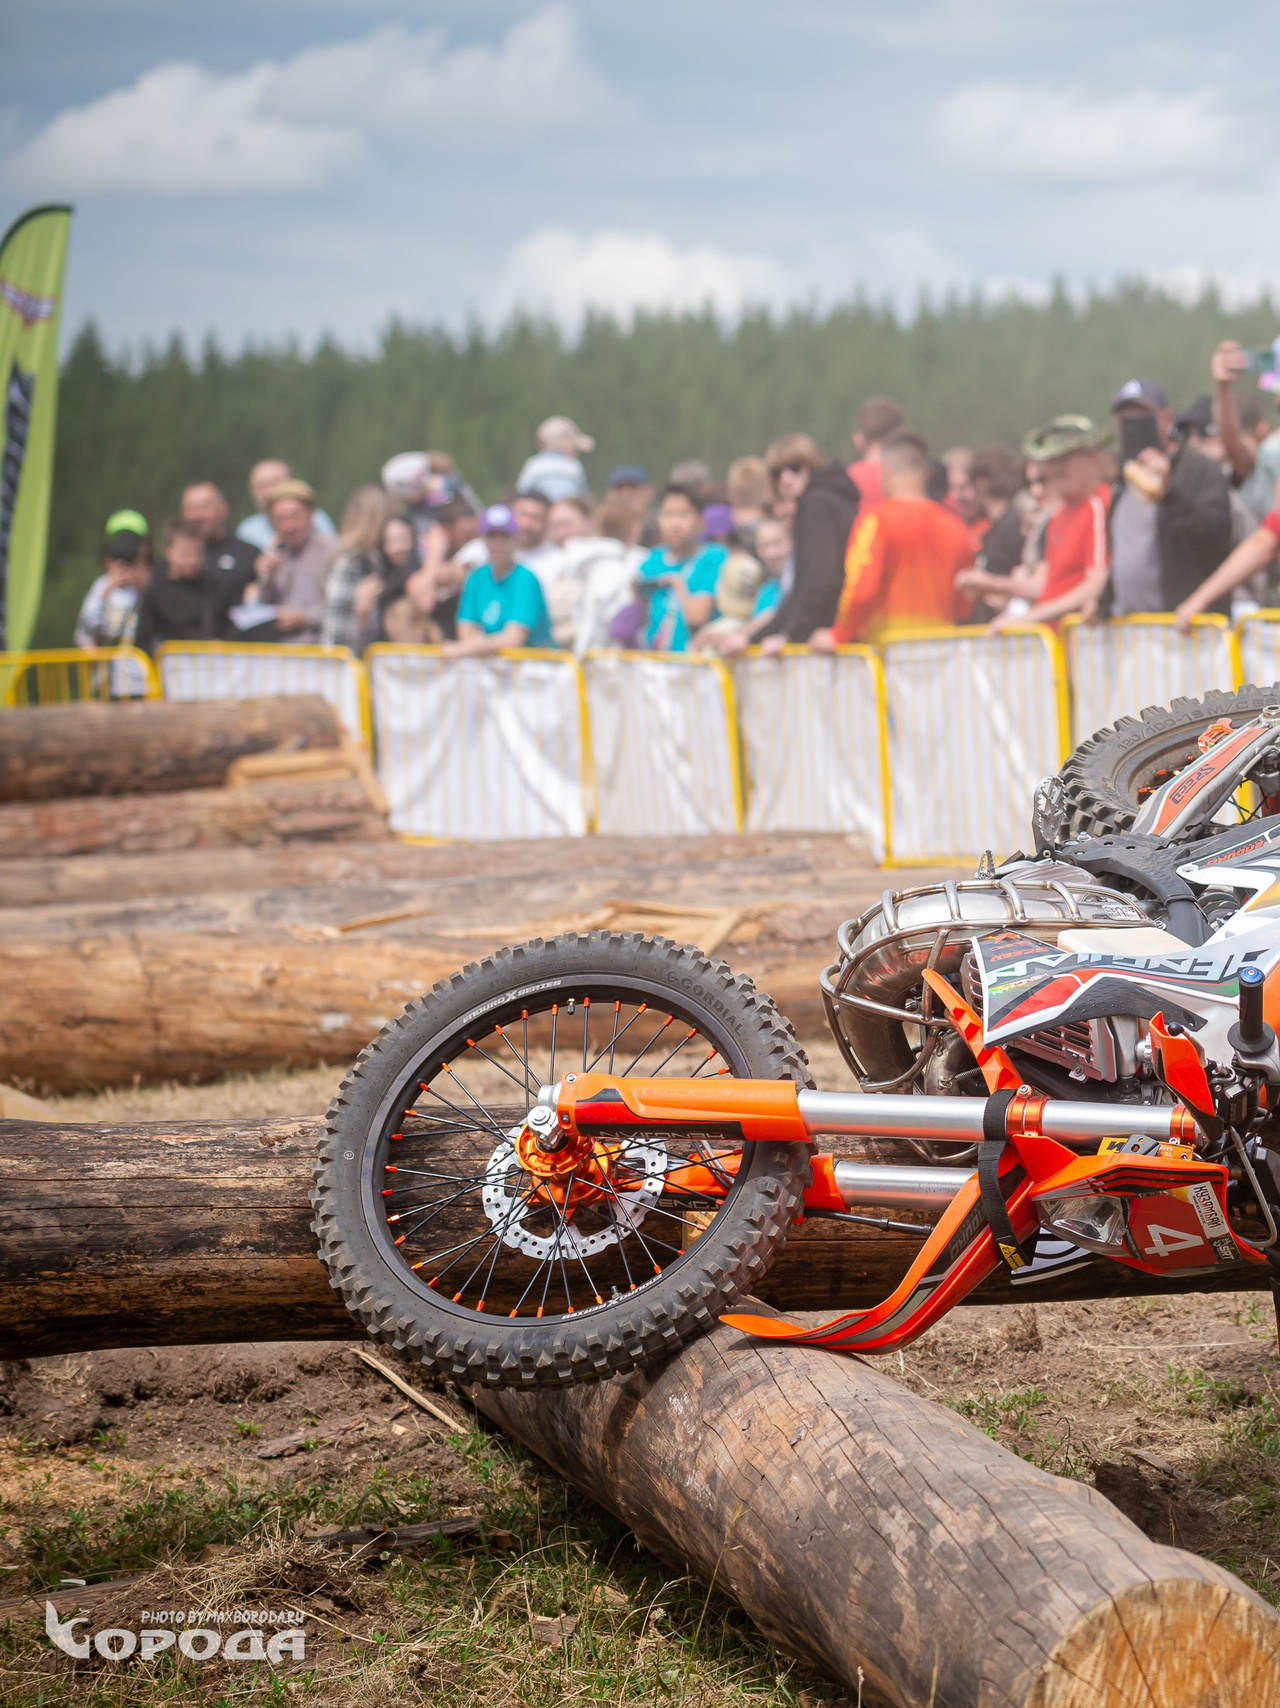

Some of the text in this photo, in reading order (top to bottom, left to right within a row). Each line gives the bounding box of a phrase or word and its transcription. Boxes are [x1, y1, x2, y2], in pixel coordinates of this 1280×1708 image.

[1207, 700, 1249, 717] M/C
[1169, 762, 1216, 805] SPEED
[1206, 839, 1264, 866] ENDURO
[681, 976, 744, 1037] CORDIAL
[948, 1205, 987, 1260] NDURO
[1144, 1224, 1204, 1257] 4
